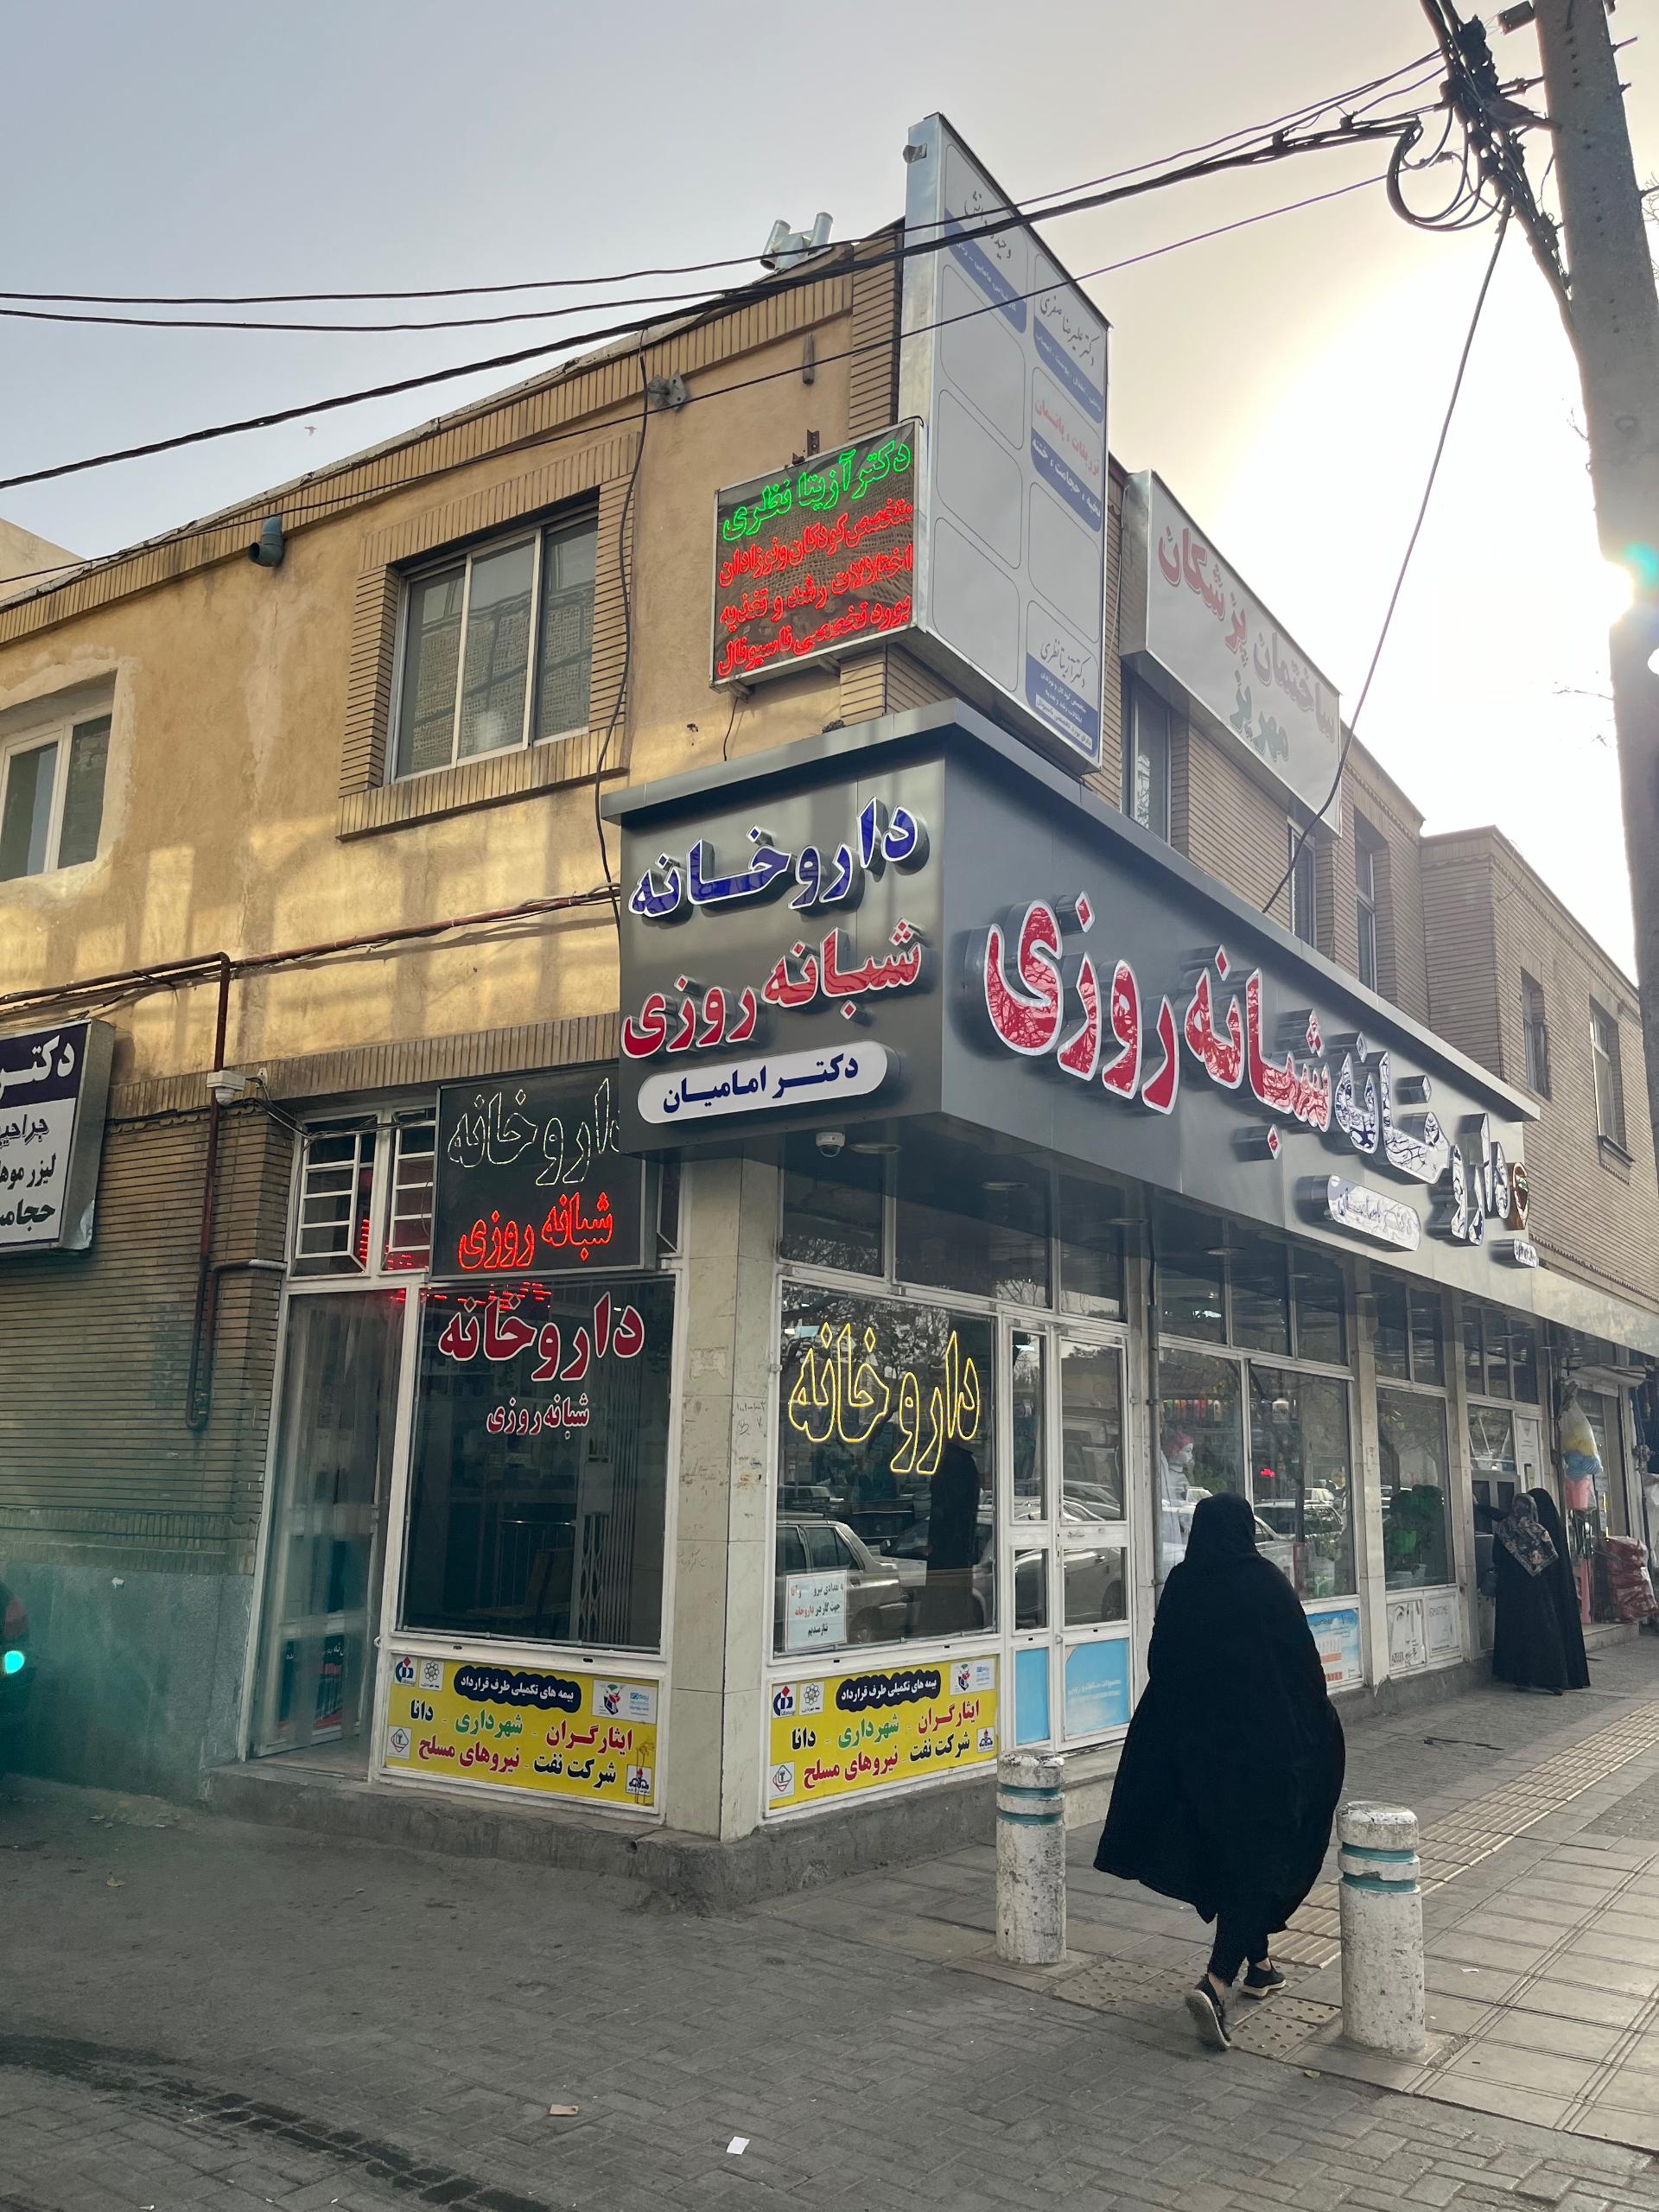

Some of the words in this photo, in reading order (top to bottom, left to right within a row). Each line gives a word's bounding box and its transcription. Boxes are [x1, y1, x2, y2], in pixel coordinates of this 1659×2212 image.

[1039, 295, 1062, 317] صفری
[1062, 315, 1084, 351] علیرضا
[1078, 334, 1101, 366] دکتر
[797, 448, 857, 512] آزیتا
[851, 439, 912, 500] دکتر
[1055, 463, 1080, 493] حجامت
[722, 479, 792, 541] نظری
[845, 498, 913, 548] متخصص
[788, 512, 849, 567] کودکان
[830, 543, 913, 594] اختلالات
[771, 595, 784, 622] و
[787, 574, 828, 610] رشد
[1158, 524, 1249, 668] پزشکان
[719, 588, 769, 633] تغذیه
[869, 594, 912, 632] بورد
[792, 601, 868, 657] تخصصی
[1040, 639, 1059, 664] نظری
[1071, 656, 1091, 689] دکتر
[1253, 631, 1336, 745] ساختمان
[628, 796, 919, 918] داروخانه
[761, 918, 923, 1020] شبانه
[621, 974, 757, 1059] روزی
[984, 890, 1180, 1116] روزی
[1184, 944, 1332, 1160] شبانه
[663, 1065, 767, 1114] امامیان
[772, 1052, 859, 1099] دکتر
[1334, 1030, 1511, 1247] داروخانه
[27, 1153, 57, 1188] لیزر
[0, 1198, 56, 1231] حجام
[541, 1191, 613, 1262] شبانه
[458, 1210, 536, 1271] روزی
[438, 1291, 645, 1382] داروخانه
[788, 1321, 981, 1475] داروخانه
[486, 1396, 543, 1436] روزی
[543, 1392, 590, 1440] شبانه
[814, 1586, 823, 1597] نیرو
[795, 1605, 815, 1618] داروخانه
[816, 1605, 822, 1617] در
[461, 1675, 490, 1692] قرارداد
[490, 1678, 510, 1694] طرف
[511, 1681, 538, 1696] تکمیلی
[539, 1685, 556, 1700] های
[558, 1688, 575, 1703] بیمه
[841, 1685, 868, 1702] قرارداد
[868, 1683, 887, 1700] طرف
[887, 1680, 911, 1697] تکمیلی
[911, 1678, 925, 1694] های
[925, 1679, 938, 1690] بیمه
[410, 1699, 434, 1722] دانا
[454, 1708, 524, 1739] شهرداری
[918, 1699, 981, 1735] ایثارگران
[418, 1735, 455, 1761] مسلح
[546, 1719, 633, 1756] ایثارگران
[791, 1726, 817, 1751] دانا
[837, 1713, 899, 1749] شهرداری
[934, 1731, 970, 1758] شرکت
[459, 1741, 520, 1774] نیروهای
[533, 1751, 563, 1776] نفت
[844, 1745, 899, 1782] نیروهای
[909, 1738, 931, 1762] نفت
[567, 1758, 617, 1789] شرکت
[803, 1758, 841, 1789] مسلح
